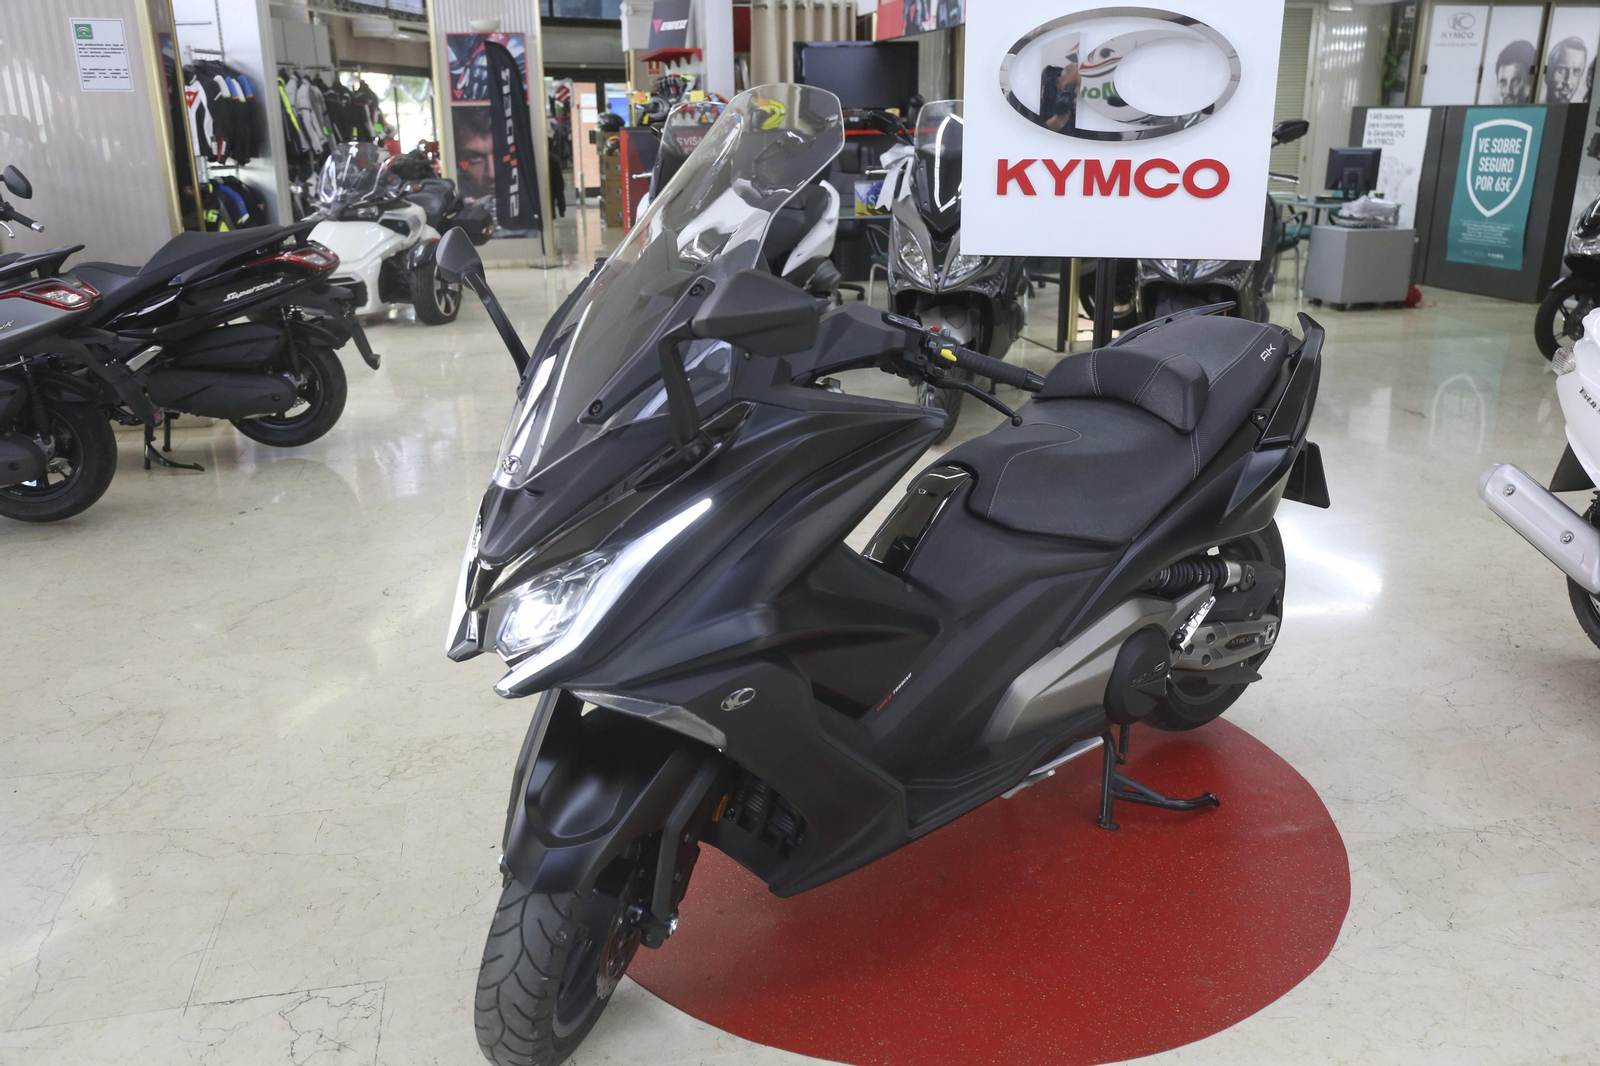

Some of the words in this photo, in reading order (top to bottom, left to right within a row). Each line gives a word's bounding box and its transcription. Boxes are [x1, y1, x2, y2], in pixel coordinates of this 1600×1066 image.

[1478, 137, 1491, 153] VE
[1491, 137, 1522, 154] SOBRE
[1478, 157, 1515, 173] SEGURO
[996, 157, 1230, 199] KYMCO
[1475, 175, 1493, 192] POR
[1494, 176, 1513, 193] 65€
[1260, 343, 1277, 361] AK
[1230, 636, 1252, 645] KYMCO
